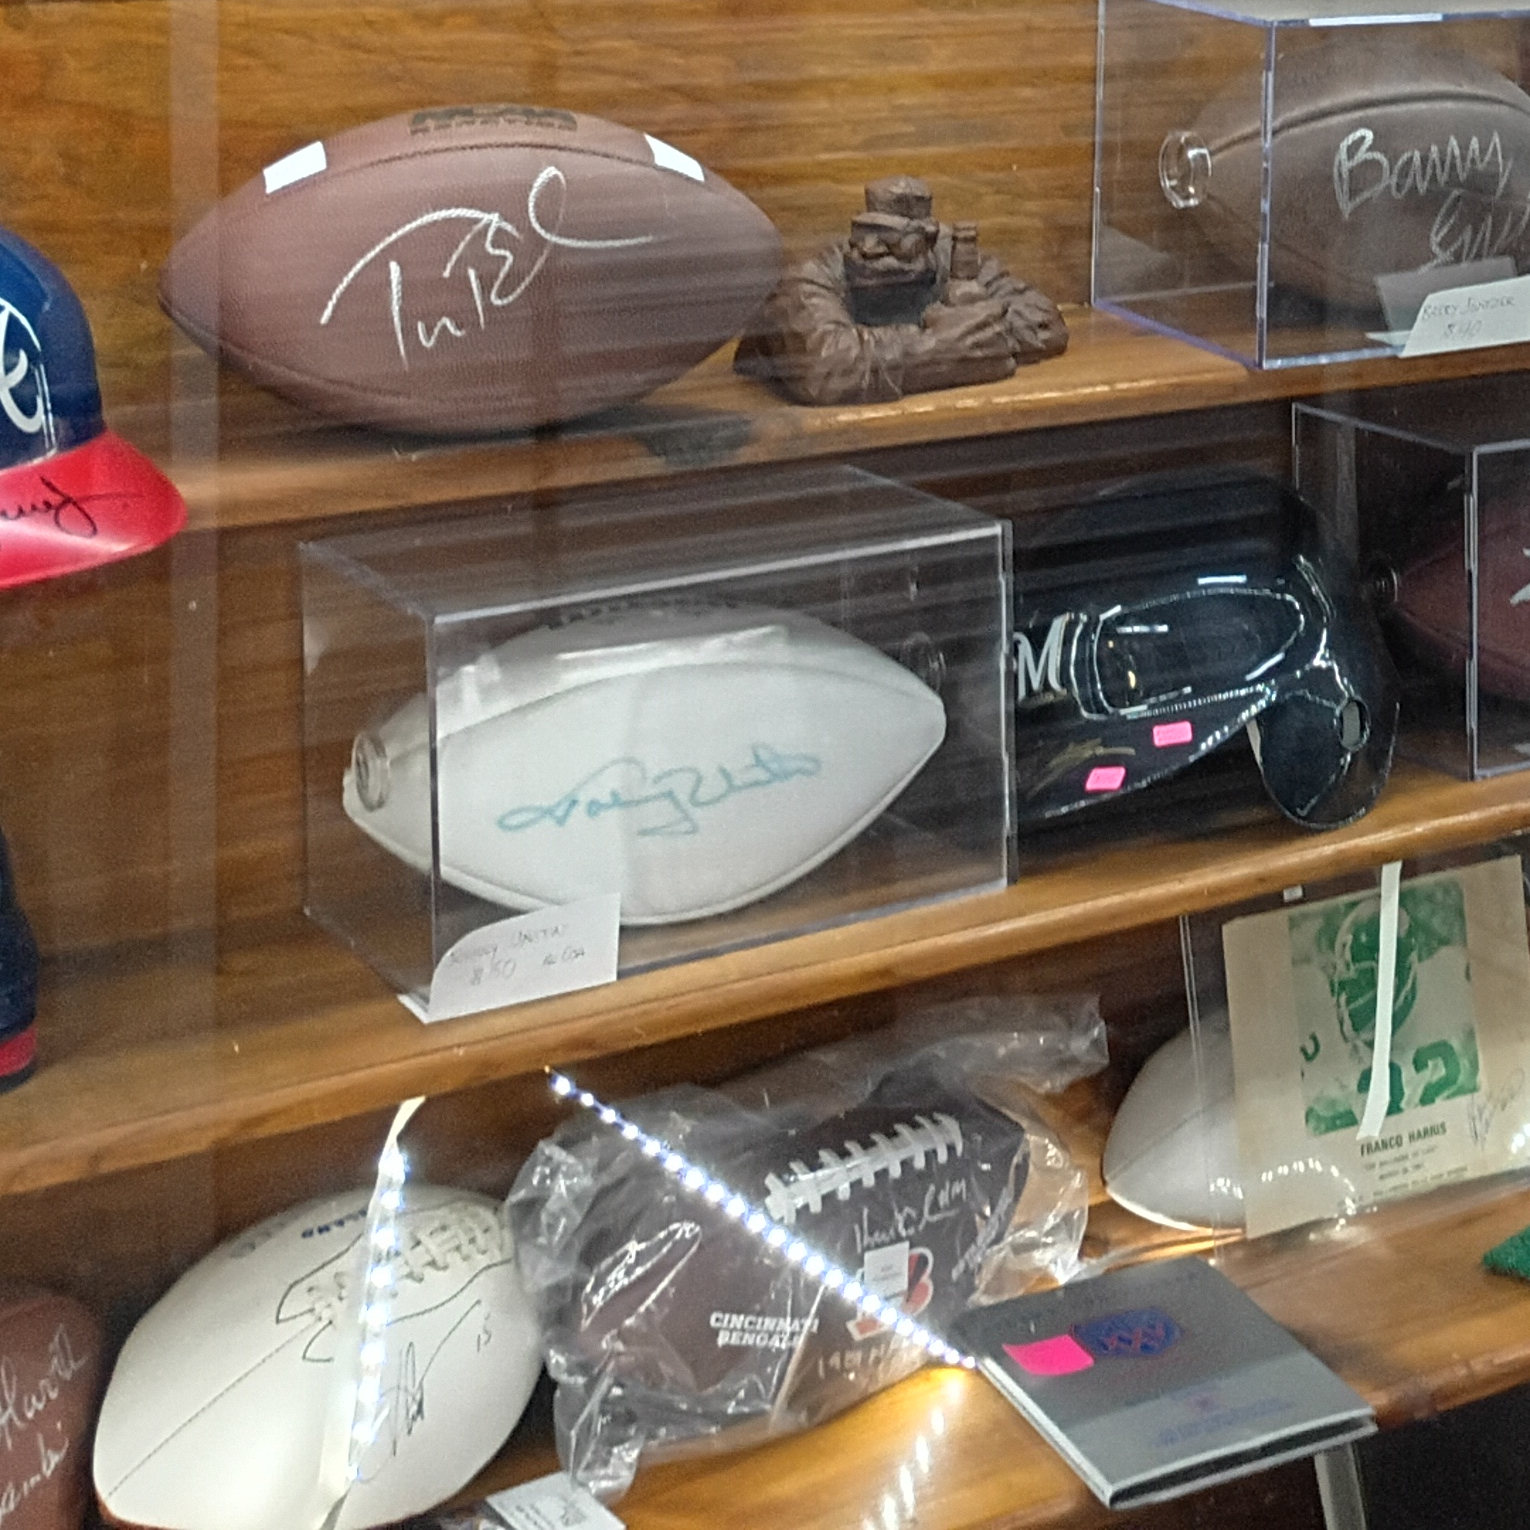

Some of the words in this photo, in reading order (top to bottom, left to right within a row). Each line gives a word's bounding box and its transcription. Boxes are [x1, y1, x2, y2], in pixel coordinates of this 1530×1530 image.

[1360, 1134, 1403, 1158] FRANCO
[1408, 1121, 1448, 1144] HARRIS
[709, 1311, 820, 1334] CINCINNATI
